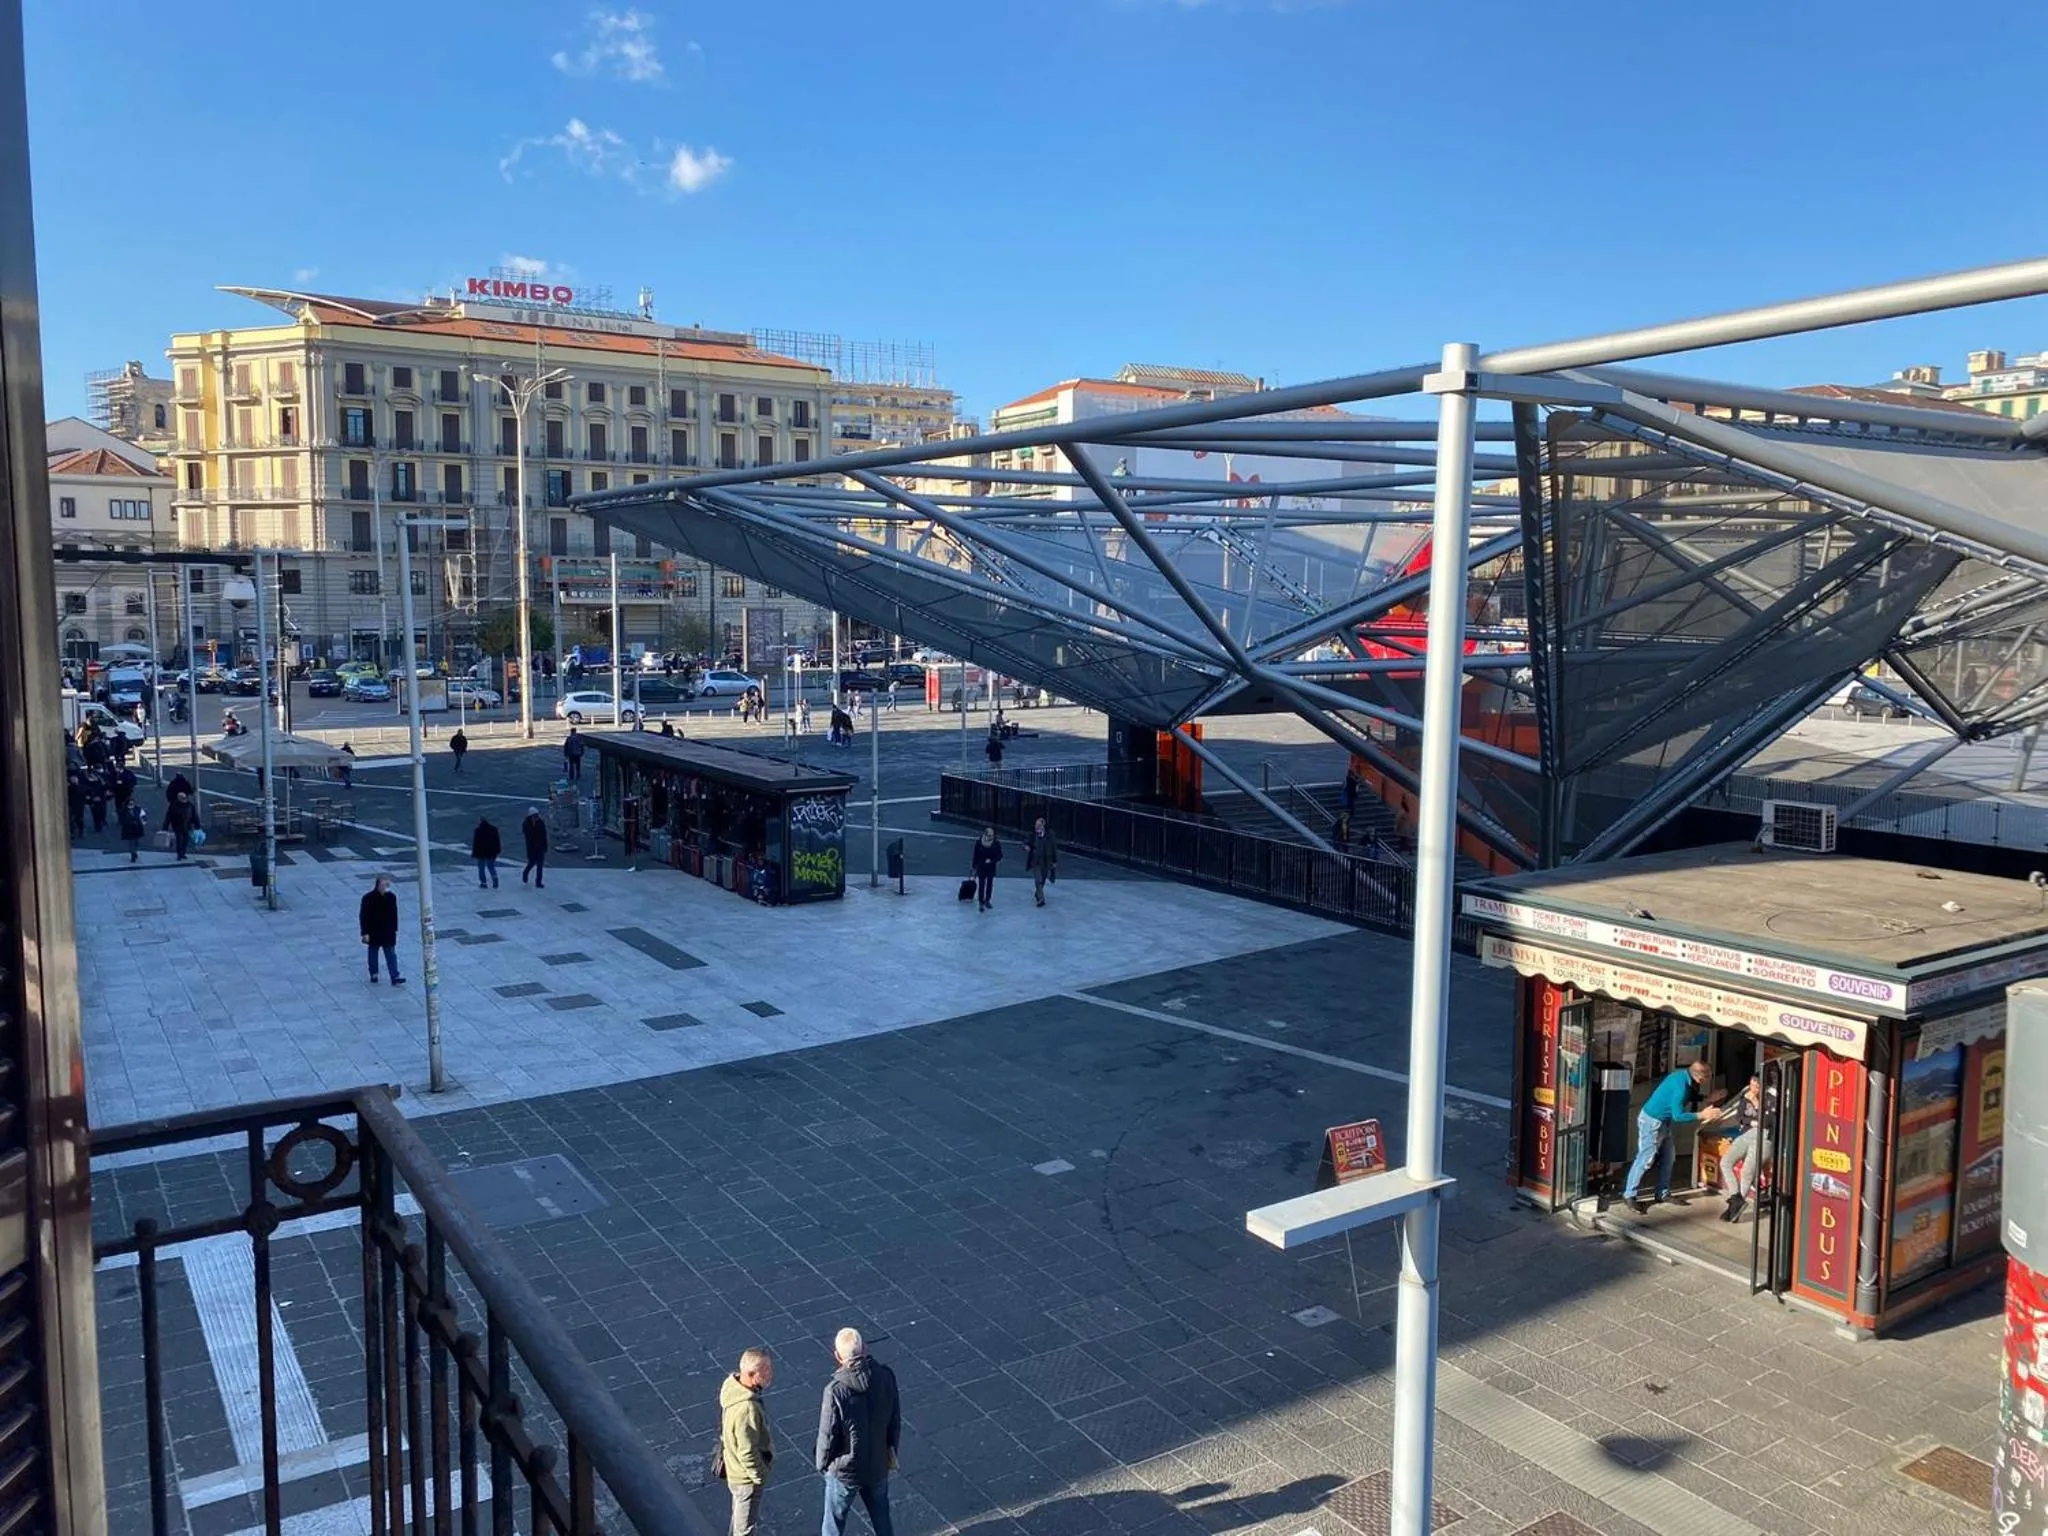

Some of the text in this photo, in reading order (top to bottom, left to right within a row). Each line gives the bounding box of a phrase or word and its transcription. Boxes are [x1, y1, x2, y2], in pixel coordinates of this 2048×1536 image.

[468, 278, 573, 305] KIMBO
[1474, 898, 1521, 917] TRAMVIA
[1533, 910, 1588, 928] TICKET POINT
[1533, 921, 1588, 939] TOURIST BUS
[1491, 942, 1545, 966] TRAMVIA
[1688, 944, 1741, 961] VESUVIUS
[1553, 955, 1606, 975] TICKET POINT
[1553, 968, 1606, 988] TOURIST BUS
[1753, 968, 1816, 987] SORRENTO
[1674, 984, 1712, 999] VESUVIUS
[1830, 976, 1890, 1001] SOUVENIR
[1722, 1007, 1768, 1025] SORRENTO
[1541, 983, 1555, 1084] OURIST
[1781, 1014, 1851, 1040] SOUVENIR
[1539, 1125, 1549, 1170] BUS
[1819, 1206, 1836, 1281] BUS
